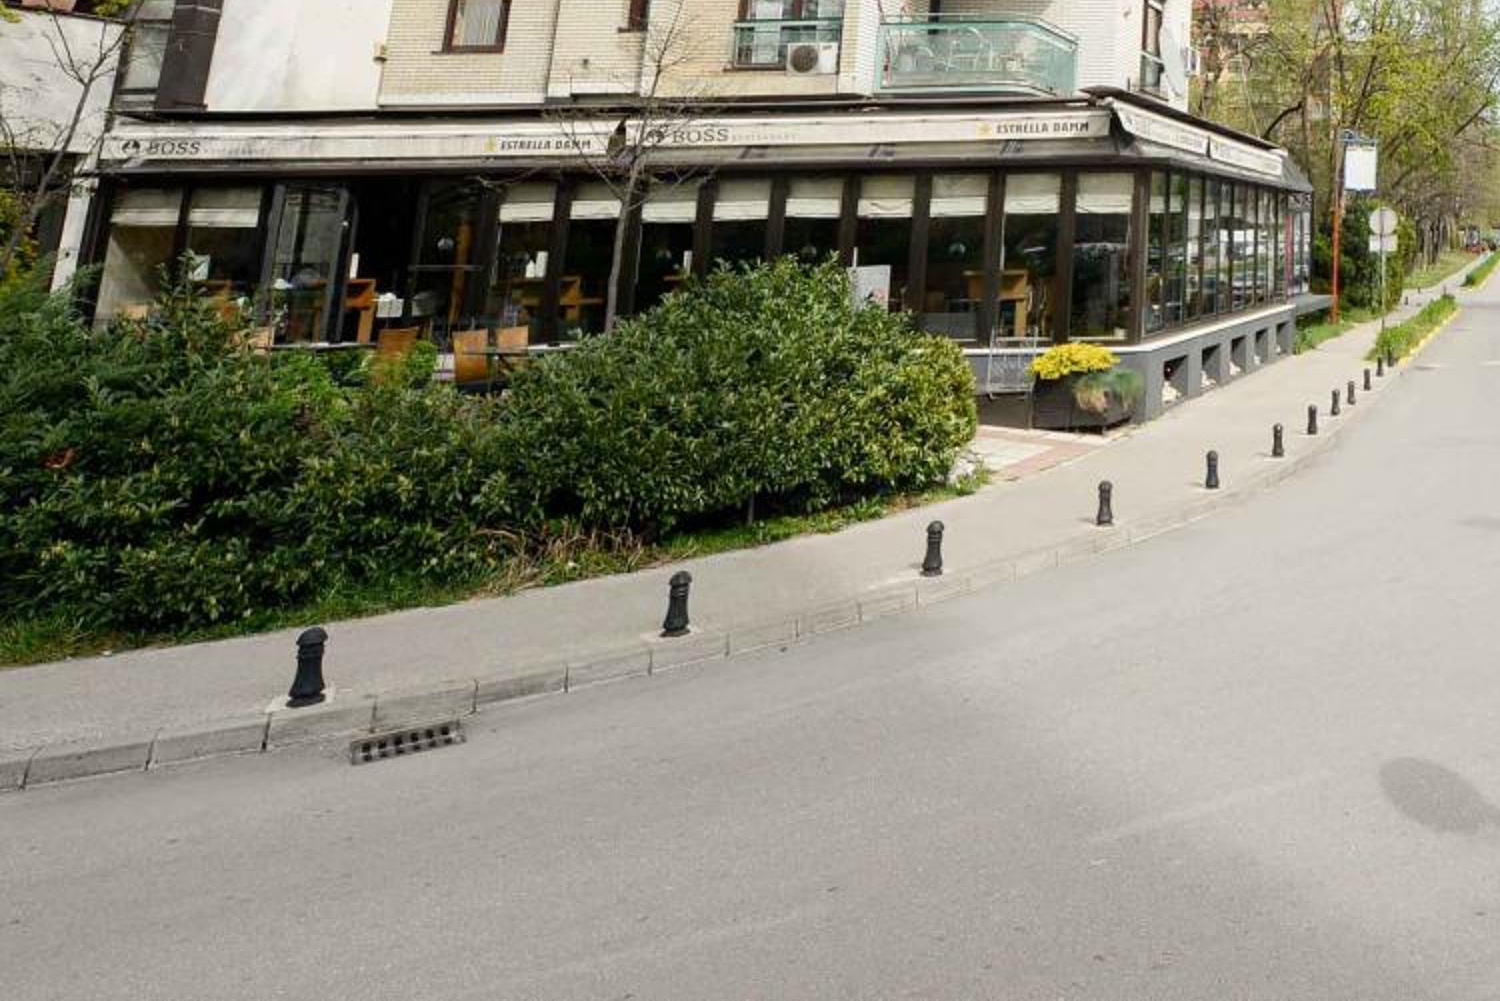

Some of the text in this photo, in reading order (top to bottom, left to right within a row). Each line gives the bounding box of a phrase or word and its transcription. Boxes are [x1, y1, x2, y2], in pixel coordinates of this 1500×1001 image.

[996, 121, 1089, 134] ESTRELLA DAMM
[672, 128, 730, 143] BOSS
[148, 140, 201, 156] BOSS
[500, 139, 592, 151] ESTRELLA DAMM
